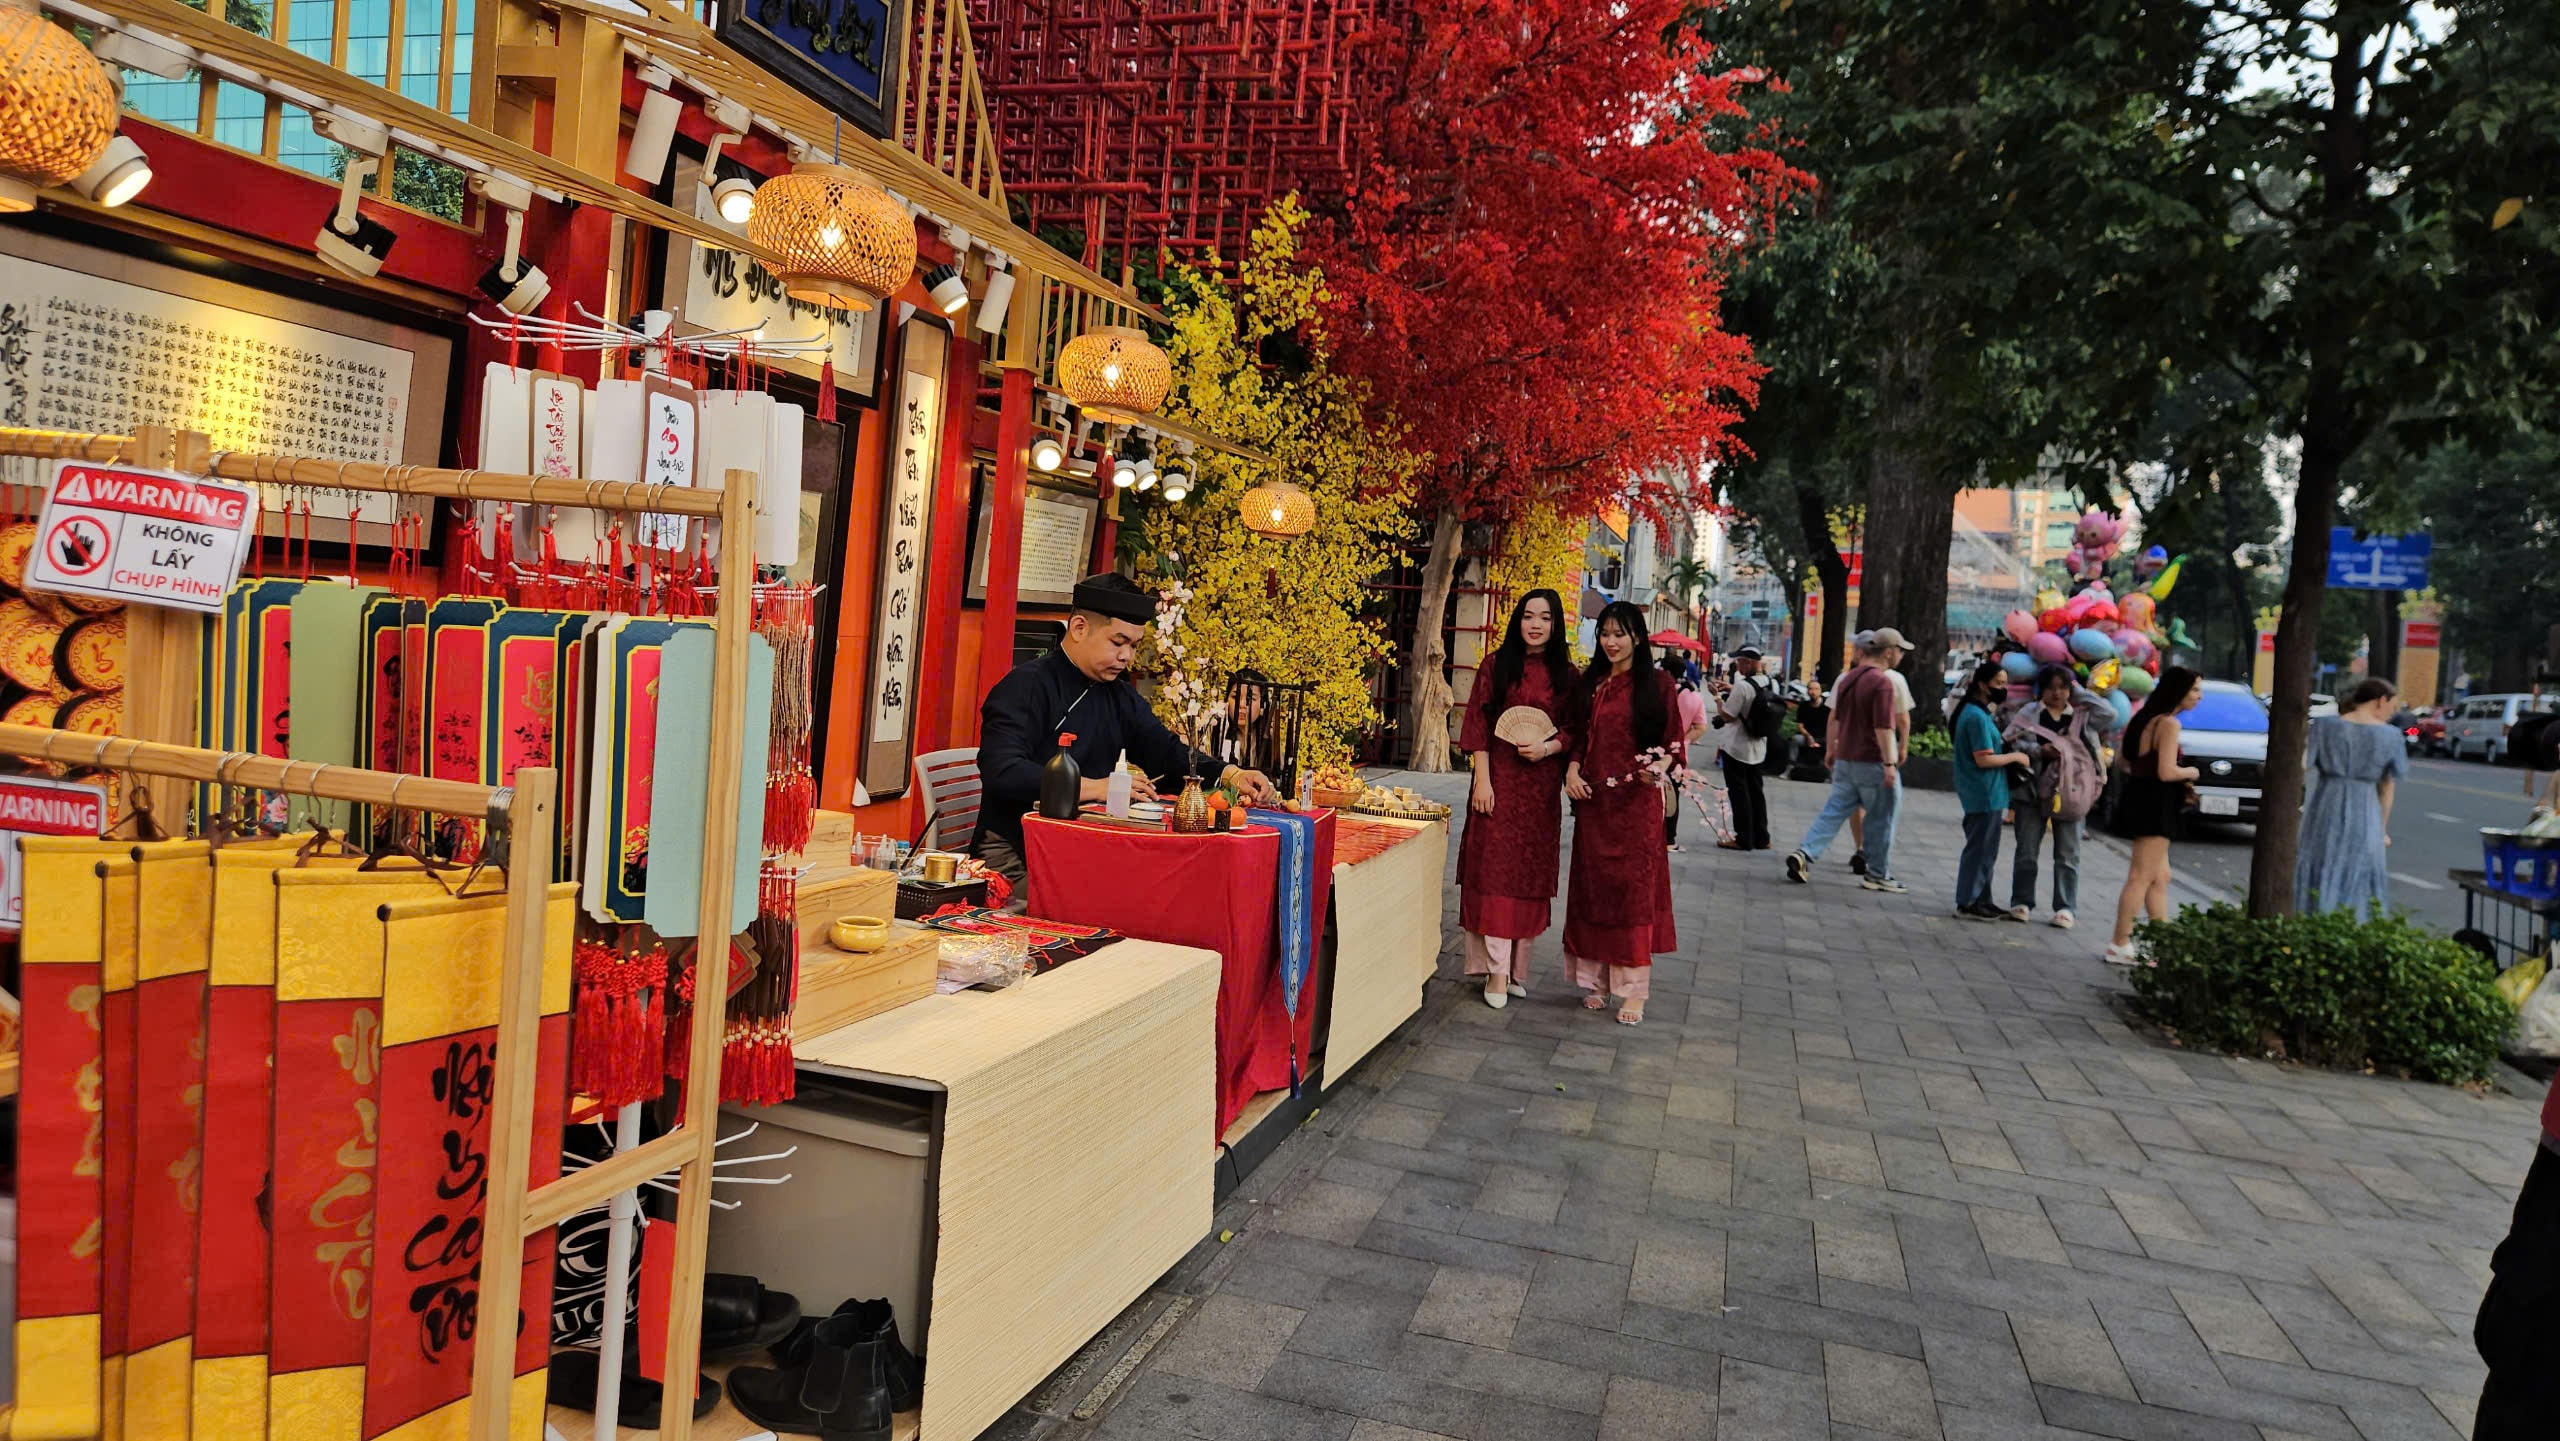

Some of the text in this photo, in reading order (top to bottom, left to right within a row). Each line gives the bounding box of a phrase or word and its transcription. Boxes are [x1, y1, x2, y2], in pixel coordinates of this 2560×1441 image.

[93, 481, 244, 521] WARNING
[142, 522, 214, 548] KHÔNG
[151, 547, 195, 572] LẤY
[114, 569, 222, 599] CHỤP HÌNH
[0, 794, 97, 829] ARNING
